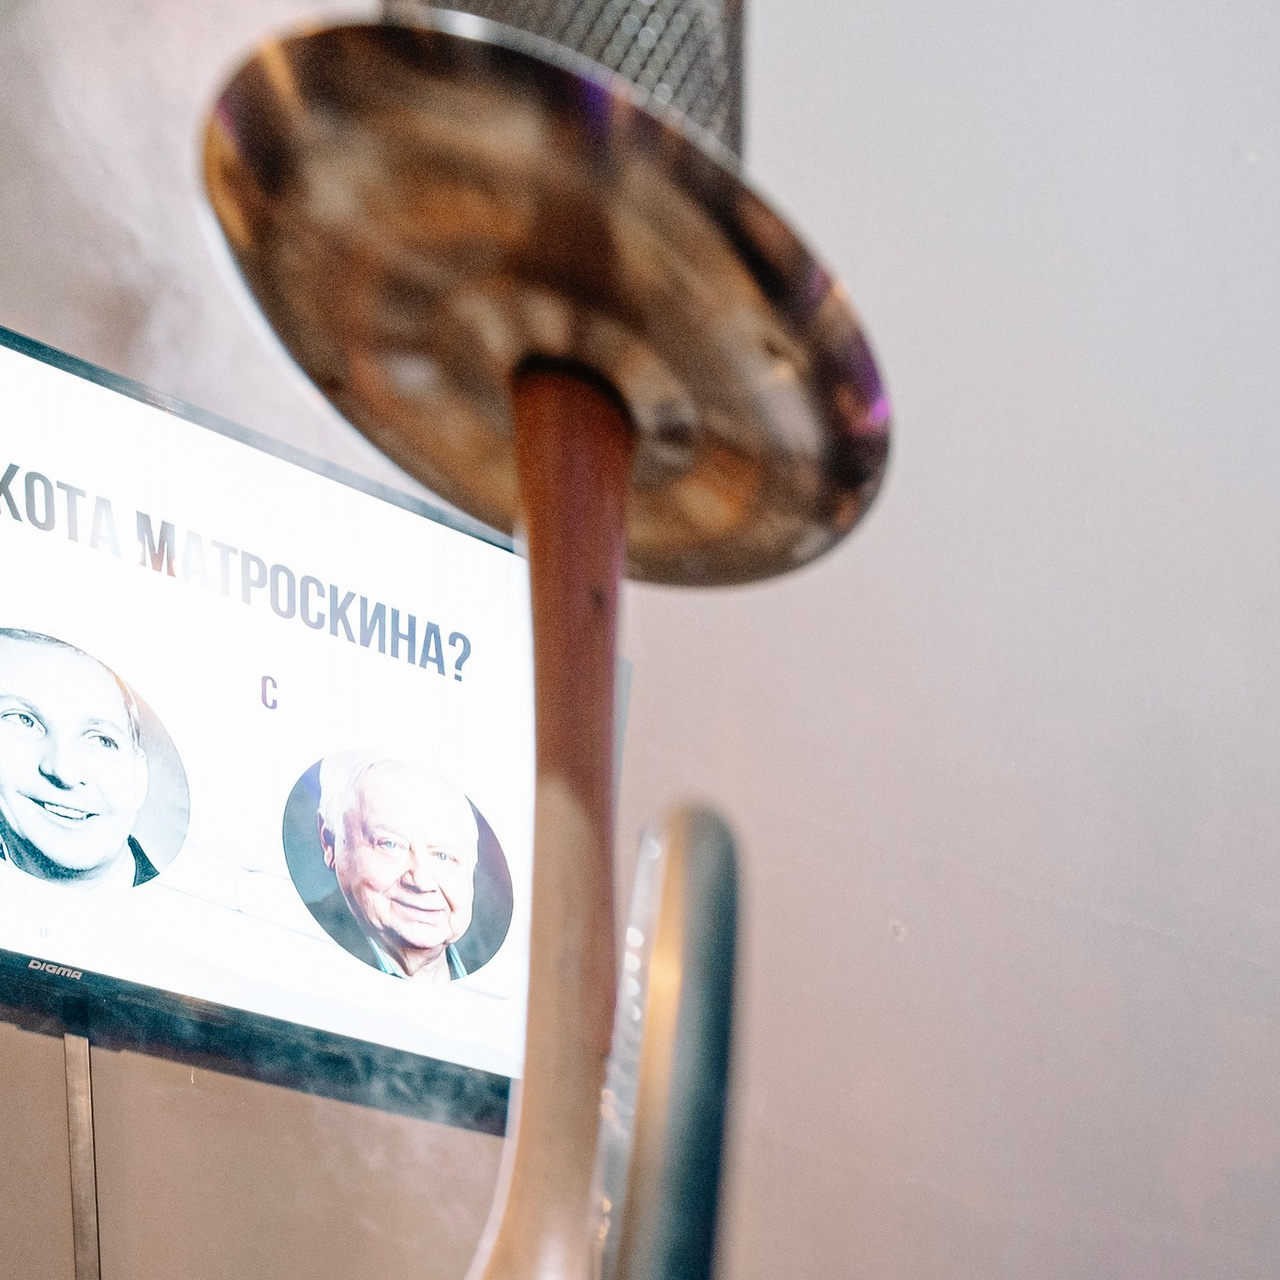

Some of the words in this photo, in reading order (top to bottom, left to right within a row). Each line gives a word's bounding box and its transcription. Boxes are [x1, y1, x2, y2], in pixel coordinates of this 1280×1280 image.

[0, 463, 121, 558] КОТА
[136, 510, 472, 682] МАТРОСКИНА?
[28, 959, 83, 980] DIGMA
